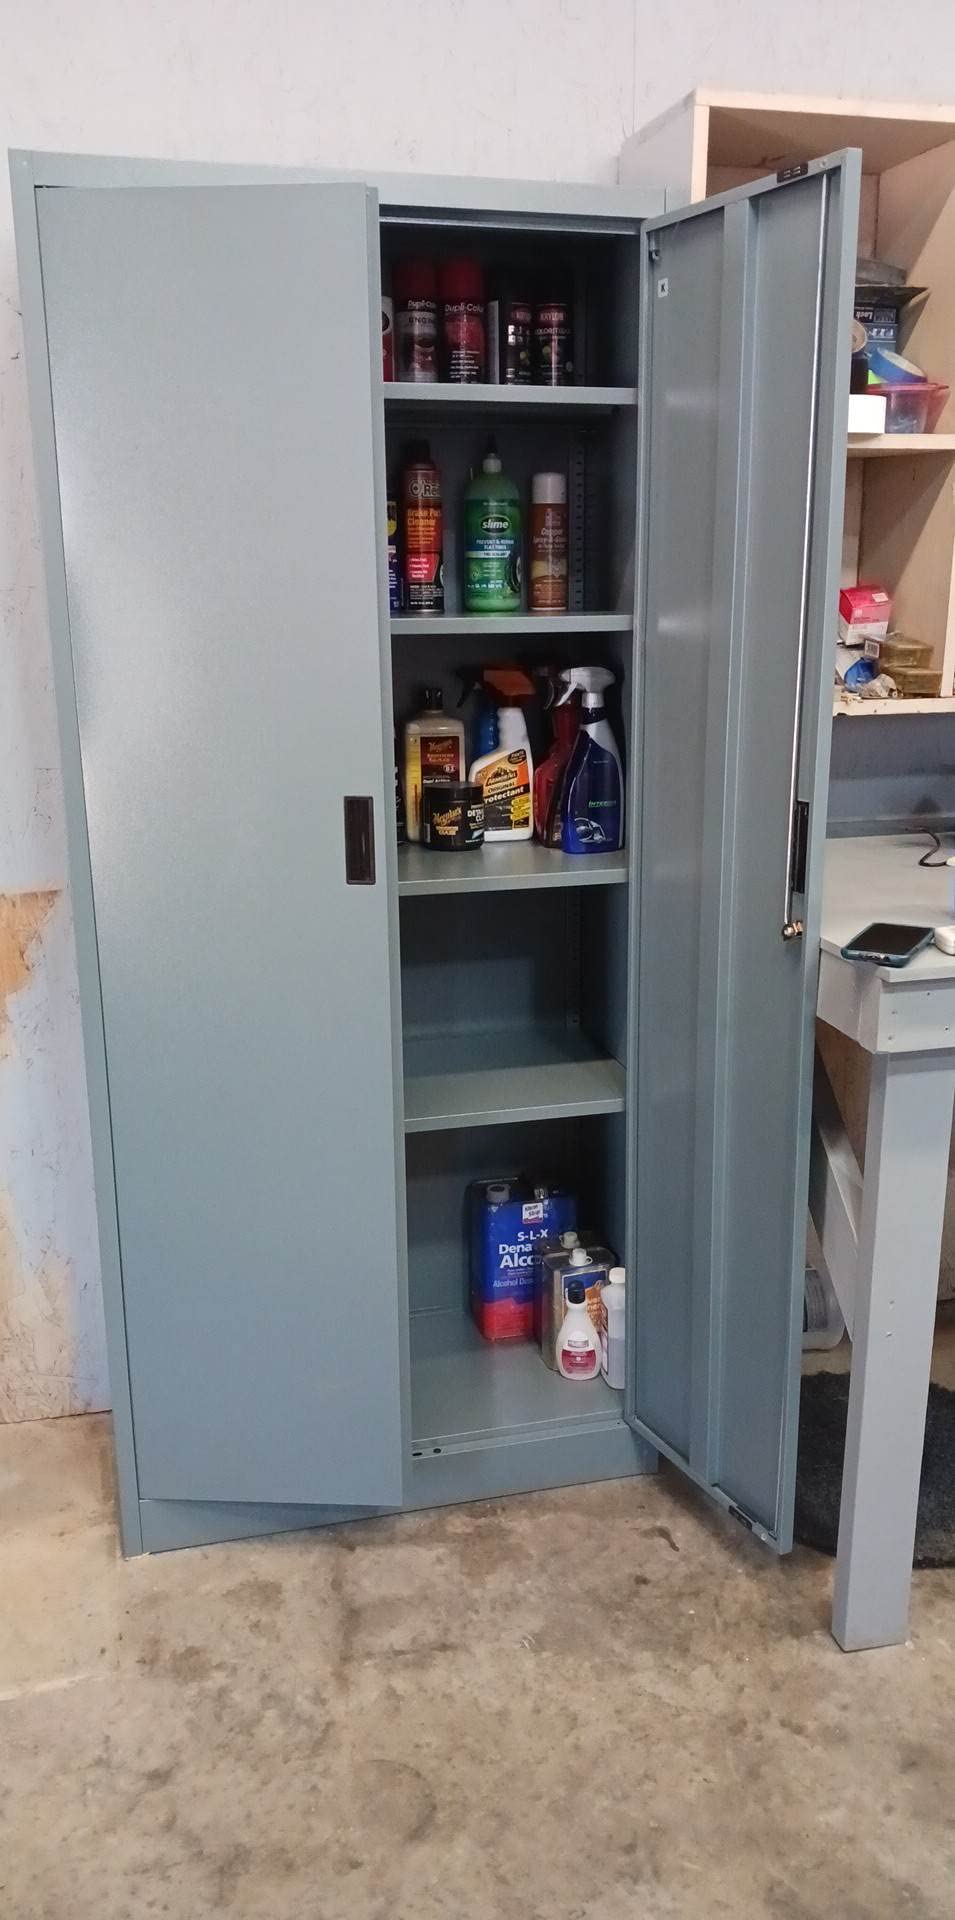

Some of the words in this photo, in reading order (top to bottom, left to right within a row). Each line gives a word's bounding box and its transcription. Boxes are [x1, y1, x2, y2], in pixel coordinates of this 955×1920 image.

[482, 518, 509, 529] slime
[484, 786, 525, 805] rotectant
[517, 1229, 549, 1242] S-L-X
[498, 1244, 533, 1255] Dena
[500, 1253, 534, 1269] Alco
